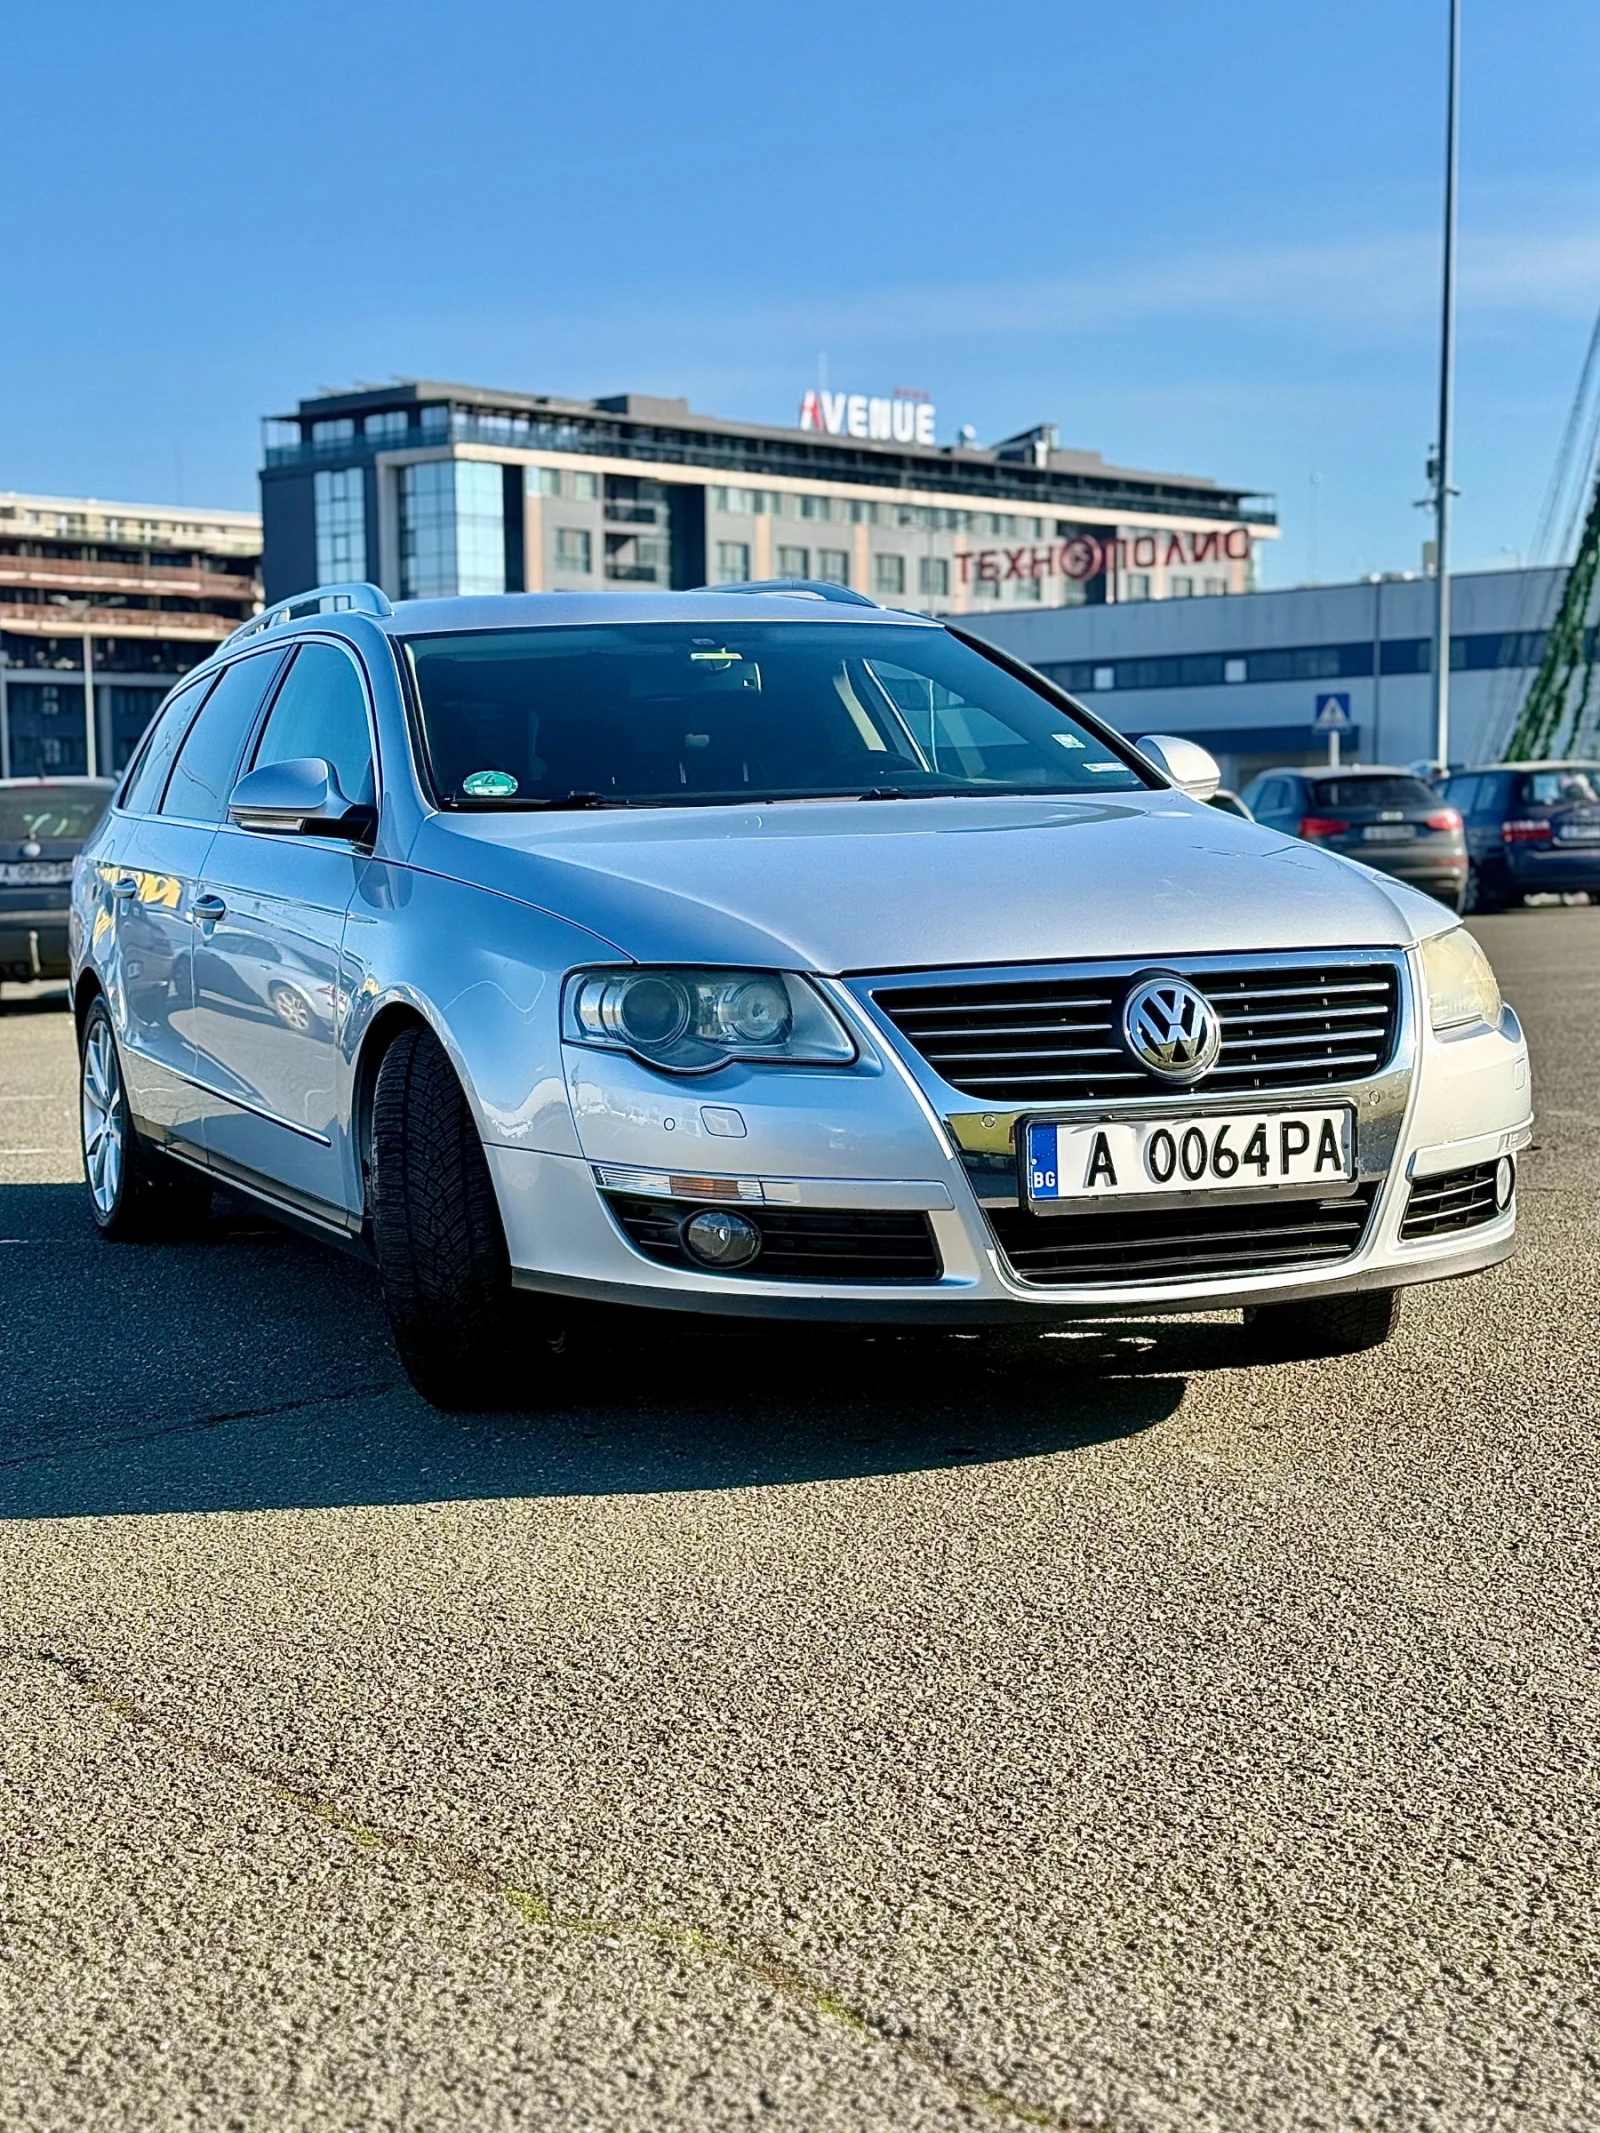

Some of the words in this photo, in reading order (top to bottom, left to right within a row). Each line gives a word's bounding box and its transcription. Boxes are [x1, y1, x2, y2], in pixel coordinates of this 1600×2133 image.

[800, 389, 936, 446] AVENUE
[484, 774, 497, 785] 4
[1126, 980, 1217, 1073] VW
[1033, 1171, 1056, 1188] BG
[1083, 1131, 1118, 1188] A
